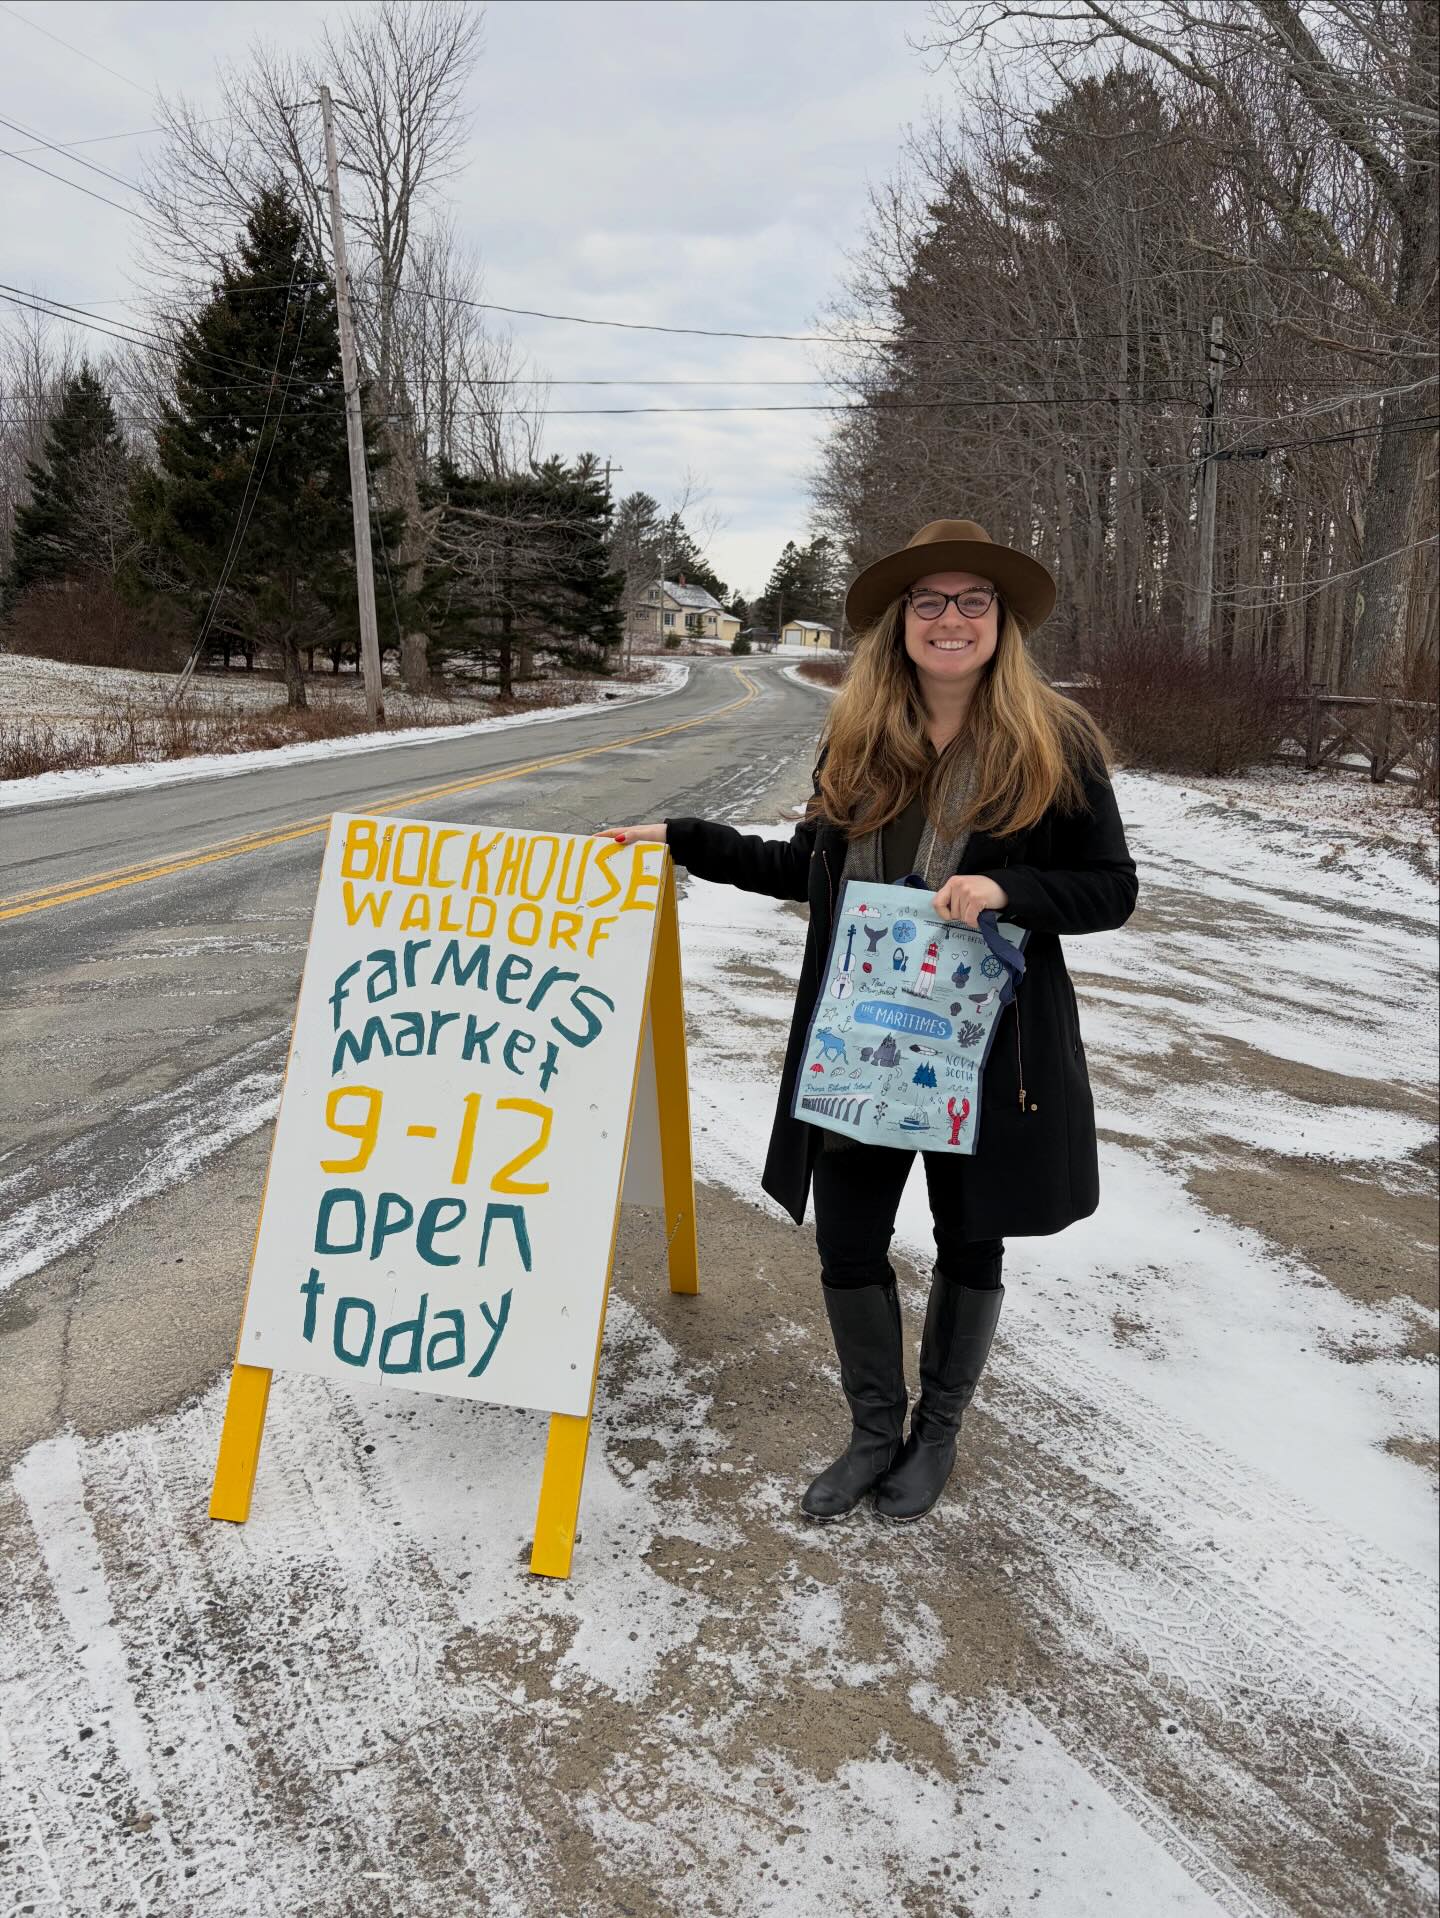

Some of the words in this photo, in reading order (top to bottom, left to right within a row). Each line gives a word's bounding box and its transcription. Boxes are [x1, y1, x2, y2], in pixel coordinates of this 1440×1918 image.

[342, 881, 619, 959] WALDORF
[861, 1004, 875, 1014] THE
[875, 1007, 948, 1036] MARITIMES
[945, 1055, 975, 1071] NOVA
[945, 1066, 973, 1081] SCOTIA
[300, 1266, 514, 1378] today
